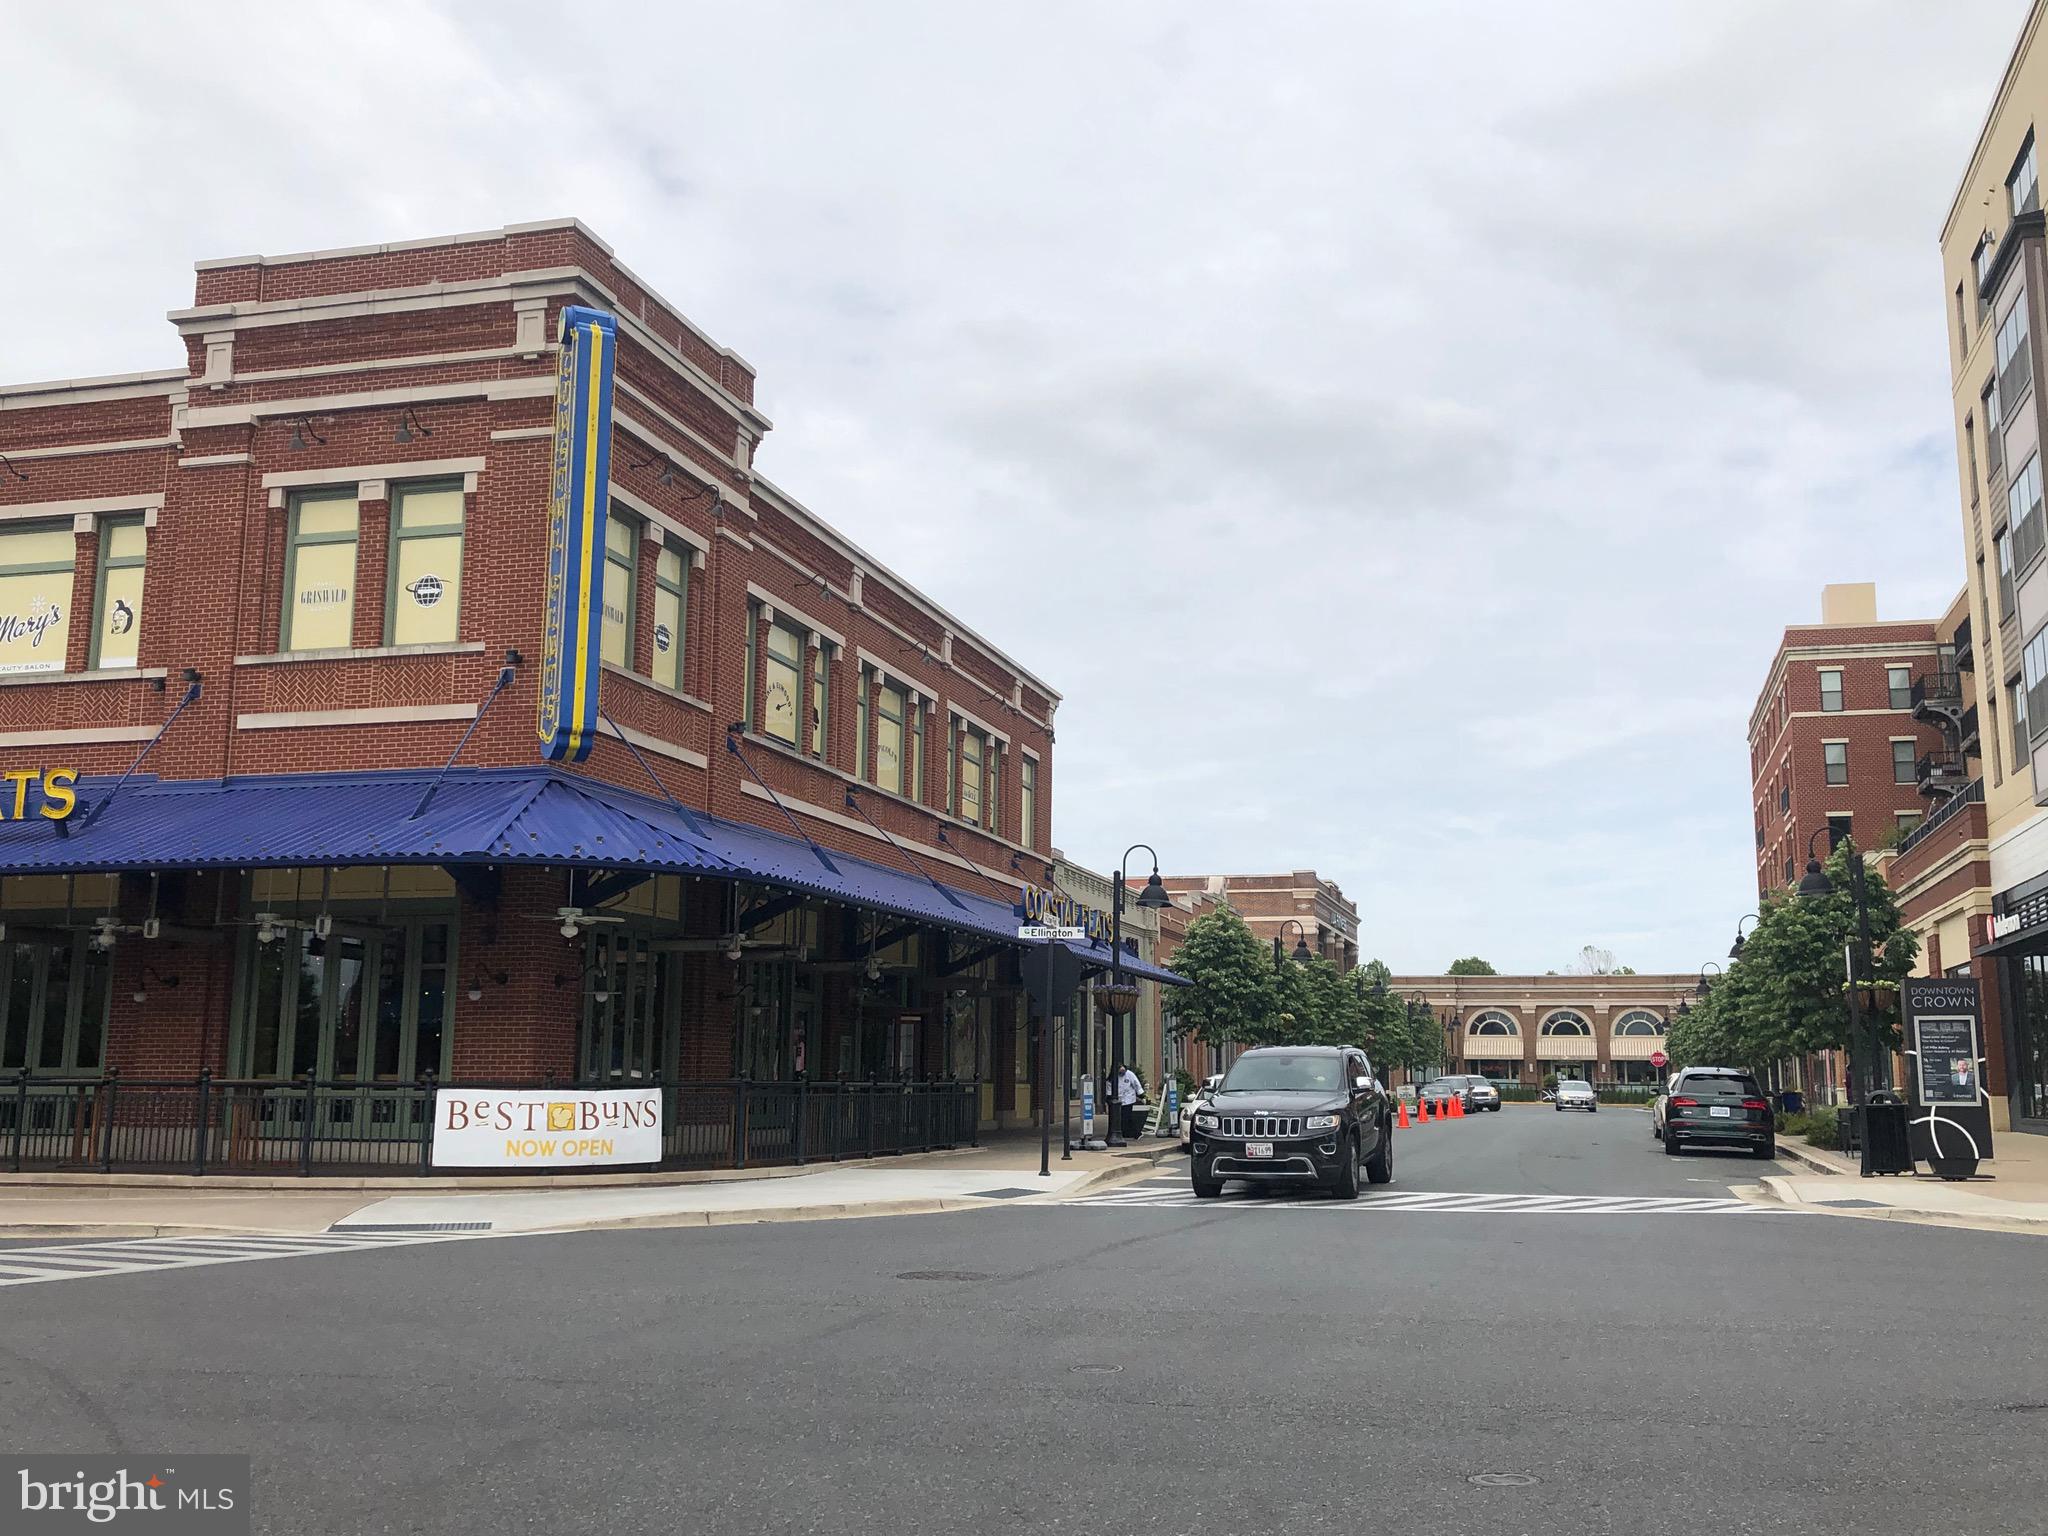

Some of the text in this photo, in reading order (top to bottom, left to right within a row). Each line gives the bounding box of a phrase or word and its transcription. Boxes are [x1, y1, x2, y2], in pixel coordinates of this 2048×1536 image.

[301, 588, 347, 605] GRISWALD
[0, 605, 62, 648] Mary's
[24, 663, 51, 671] SALON
[0, 767, 78, 822] TS
[1031, 928, 1073, 938] Ellington
[1911, 986, 1975, 996] DOWNTOWN
[1912, 996, 1976, 1009] CROWN
[506, 1138, 614, 1158] NOW OPEN
